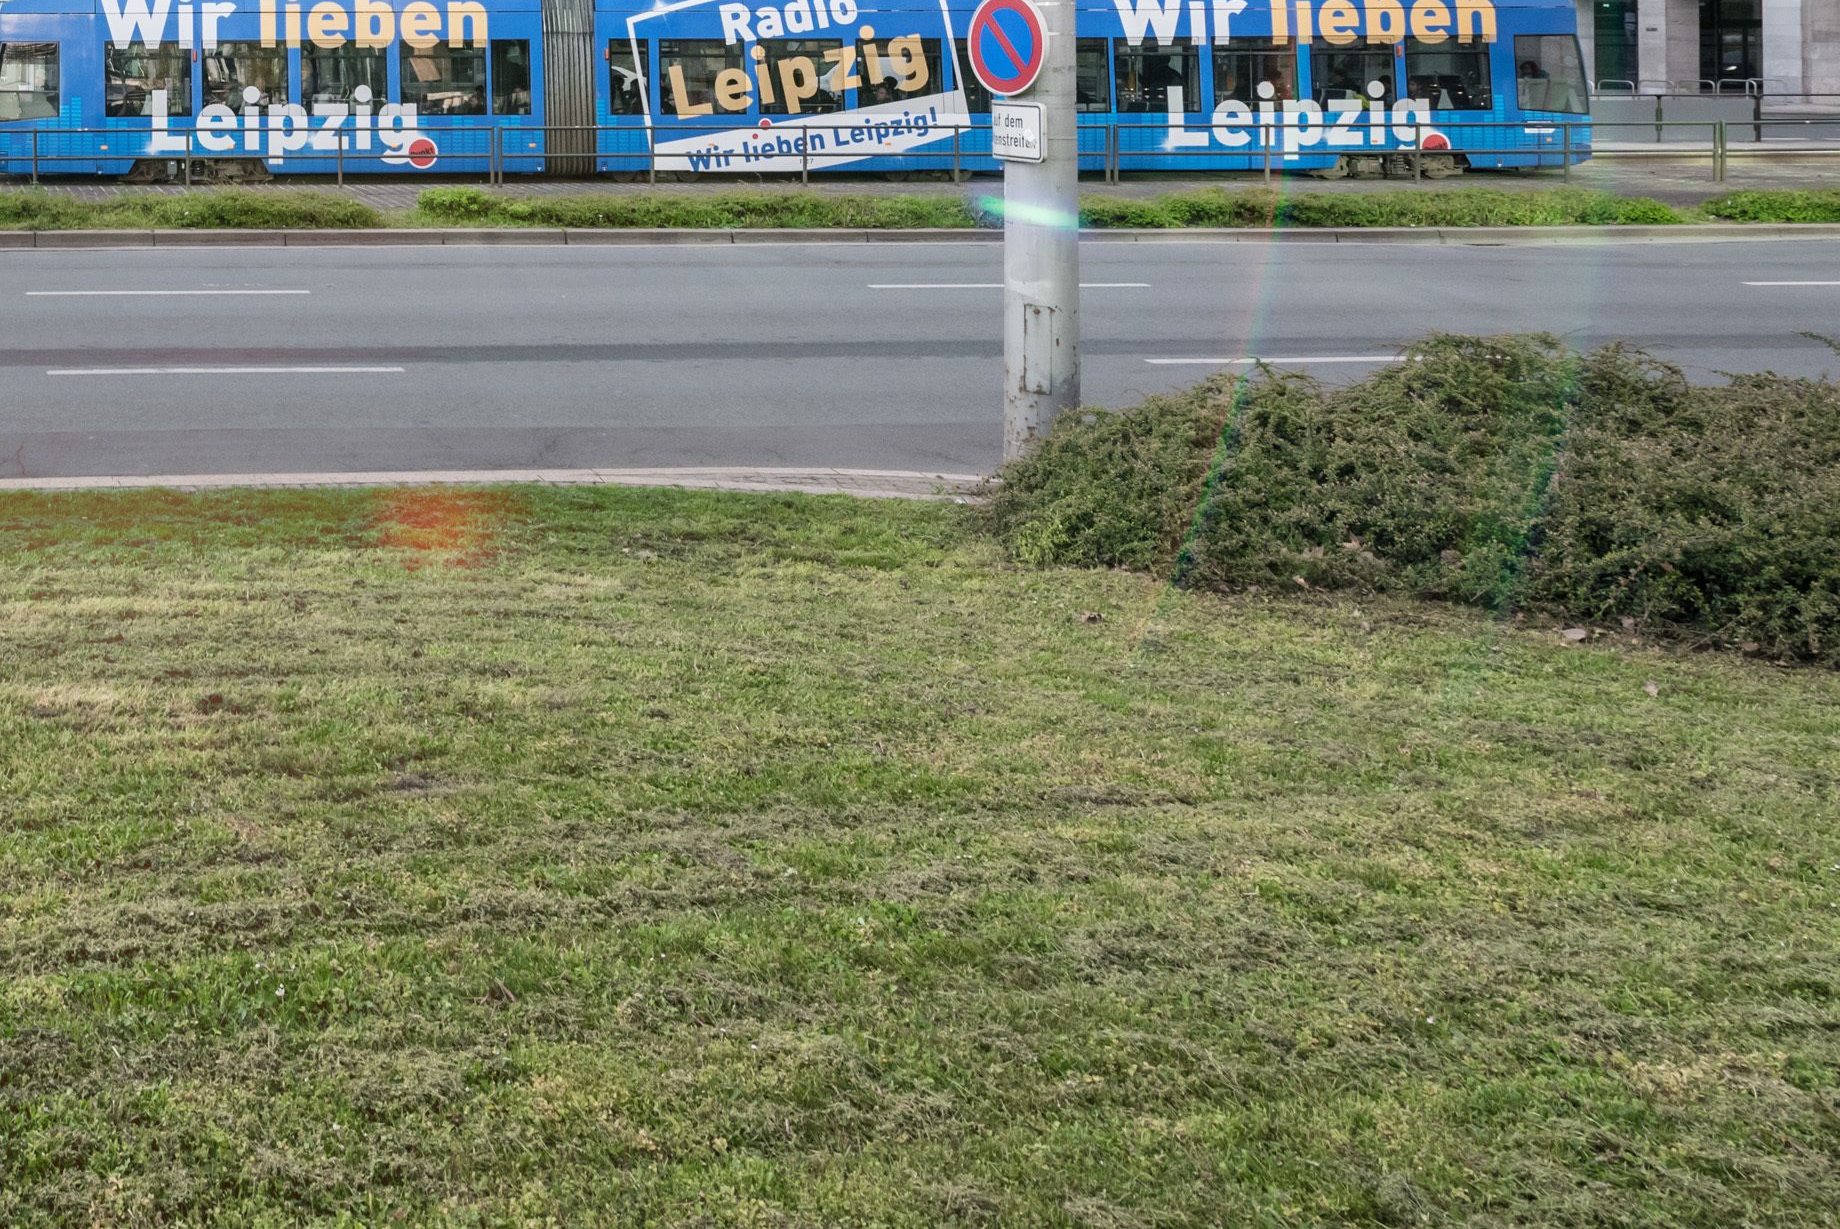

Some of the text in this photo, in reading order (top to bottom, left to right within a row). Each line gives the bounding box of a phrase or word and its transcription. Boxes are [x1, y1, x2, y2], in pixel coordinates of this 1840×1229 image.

[669, 25, 930, 120] Leipzig
[150, 84, 418, 166] Leipzig
[685, 107, 938, 173] Wir lieben Leipzig!
[1004, 114, 1024, 129] dem
[1167, 80, 1431, 161] Leipzig
